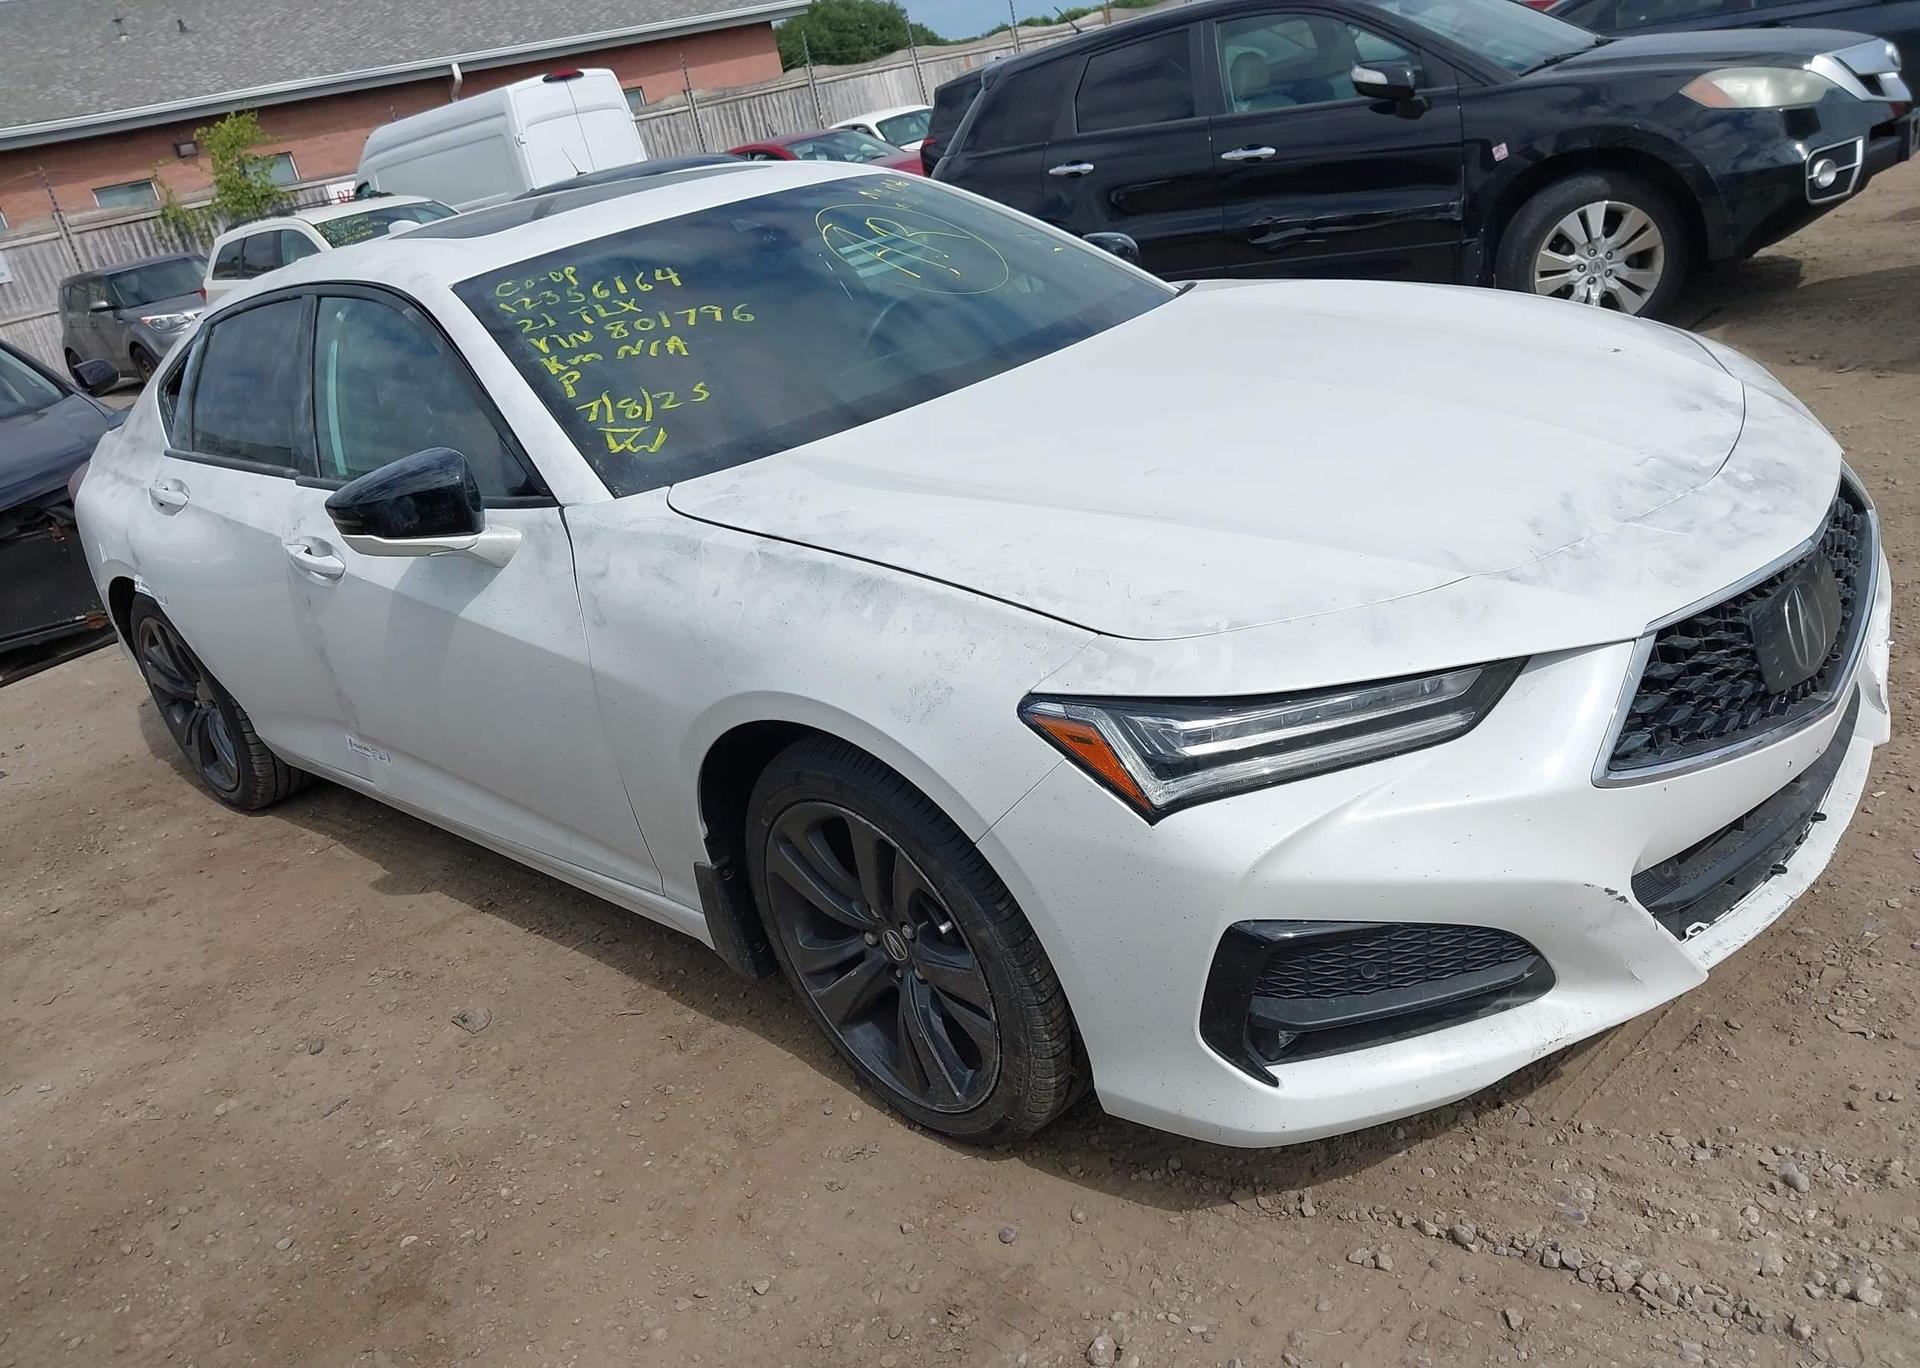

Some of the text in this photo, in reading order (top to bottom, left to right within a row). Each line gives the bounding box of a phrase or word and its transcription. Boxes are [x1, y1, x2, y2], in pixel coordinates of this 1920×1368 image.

[499, 267, 682, 313] 12356164
[515, 298, 642, 334] 21 TLX
[604, 303, 755, 339] 801796
[558, 370, 582, 399] P
